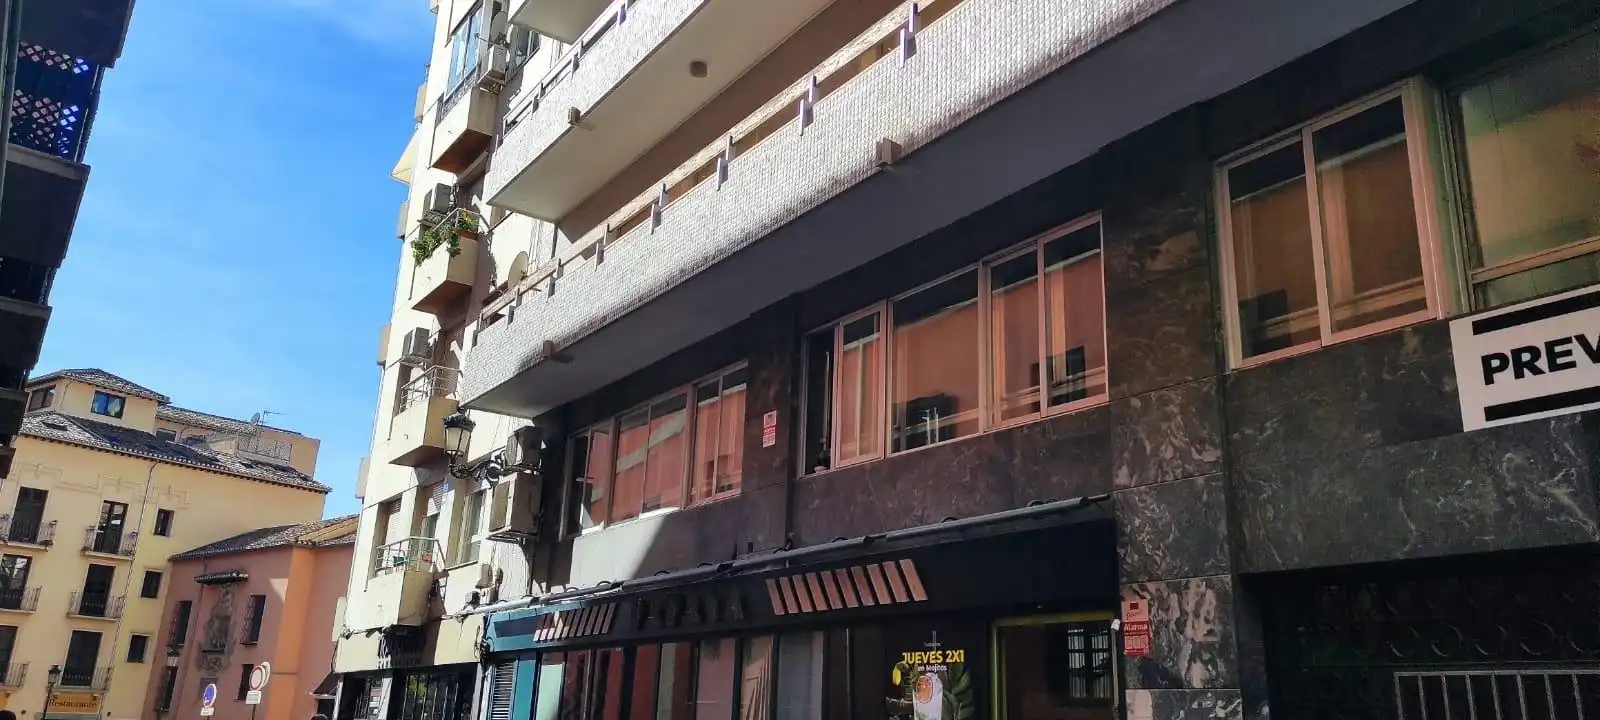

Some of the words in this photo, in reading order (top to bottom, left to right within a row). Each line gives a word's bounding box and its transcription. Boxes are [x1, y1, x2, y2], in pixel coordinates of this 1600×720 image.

[1481, 333, 1600, 386] PREV
[902, 651, 943, 663] JUEVES
[946, 649, 964, 662] 2X1
[48, 698, 97, 708] Restaurante
